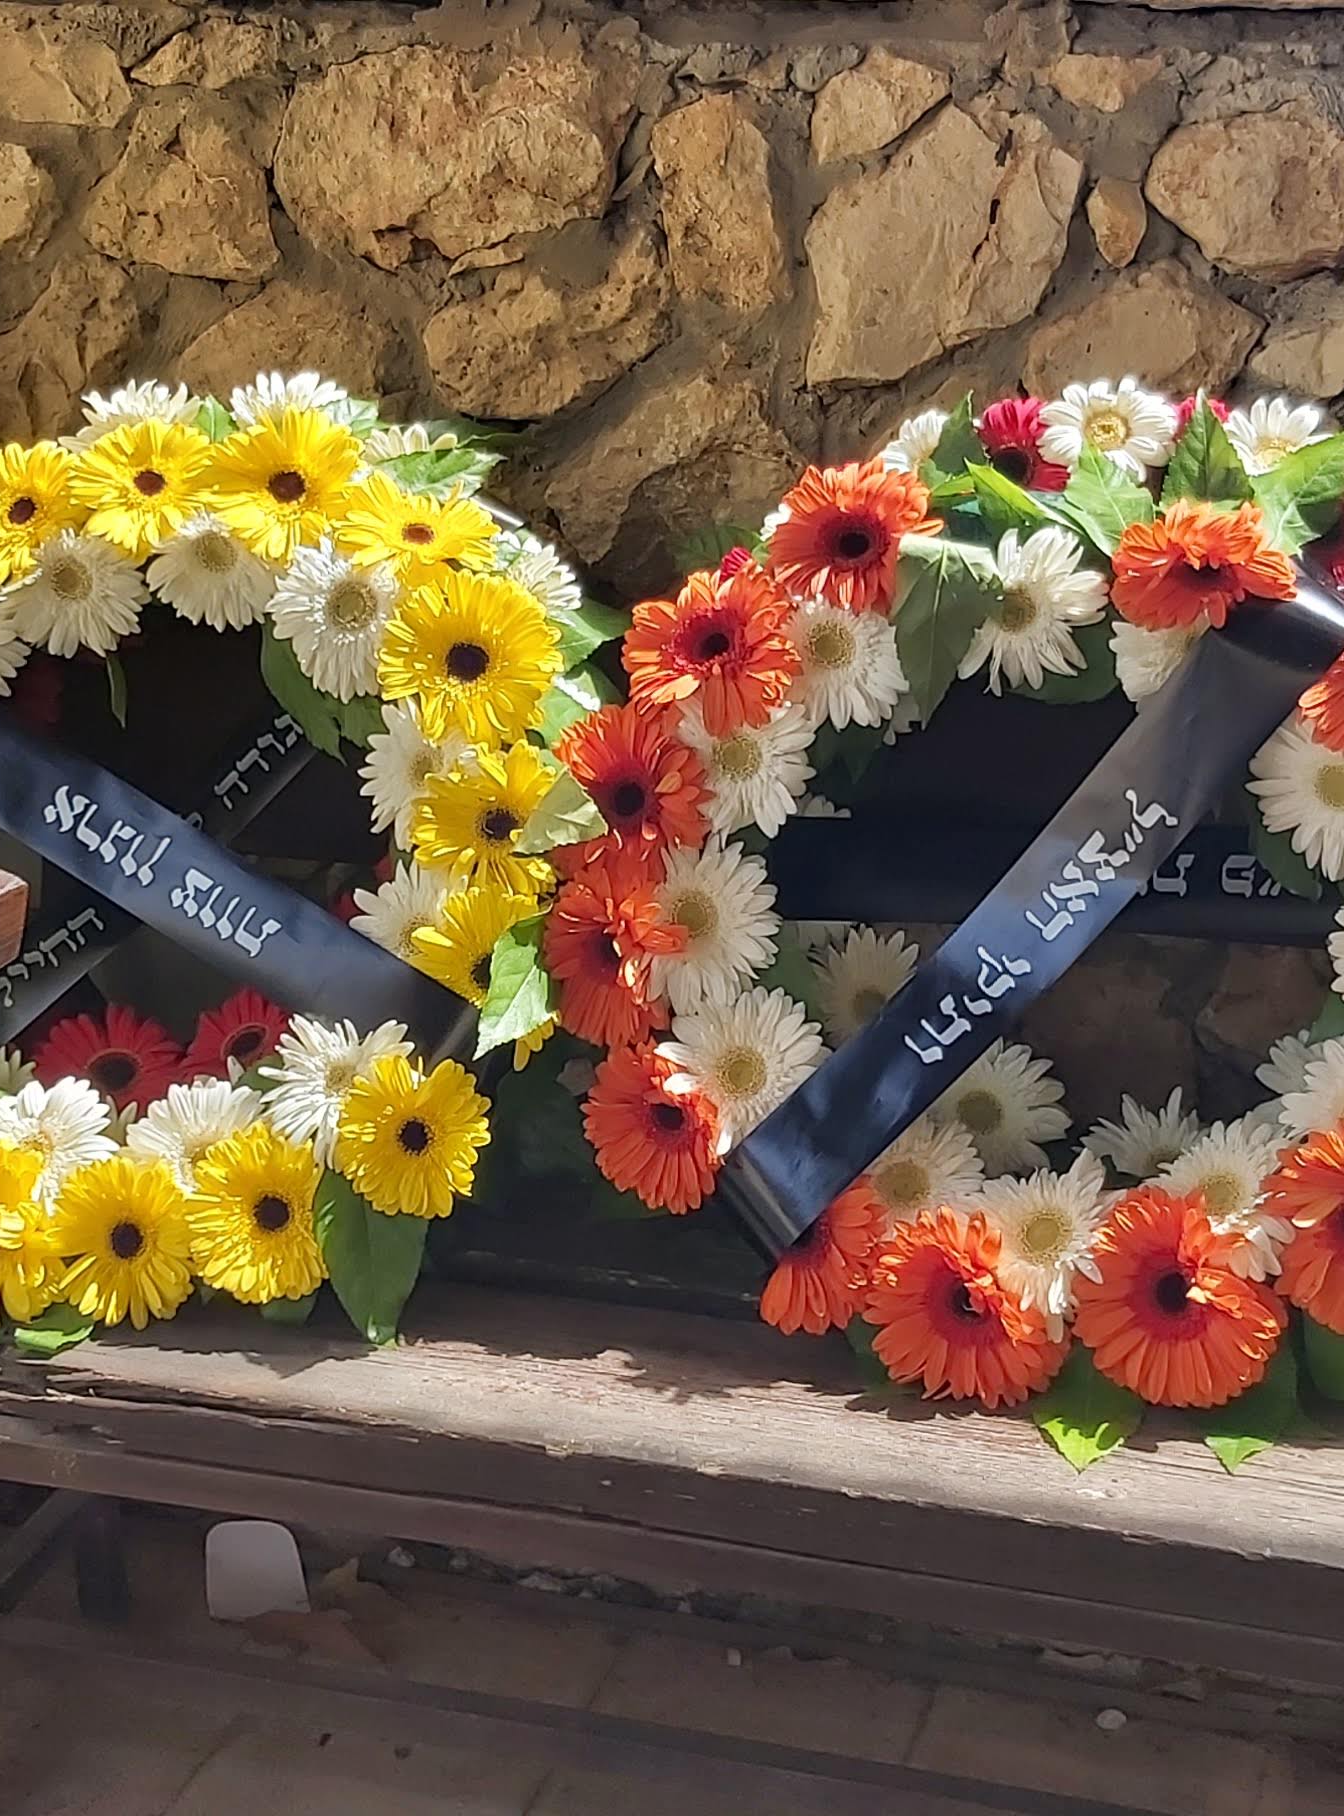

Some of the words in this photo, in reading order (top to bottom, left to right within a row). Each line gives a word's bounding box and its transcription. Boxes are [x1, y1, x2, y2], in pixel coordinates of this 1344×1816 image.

[212, 713, 304, 809] גודה
[44, 785, 171, 886] ארגון
[170, 868, 283, 957] צוות
[904, 945, 1032, 1065] ותיקי
